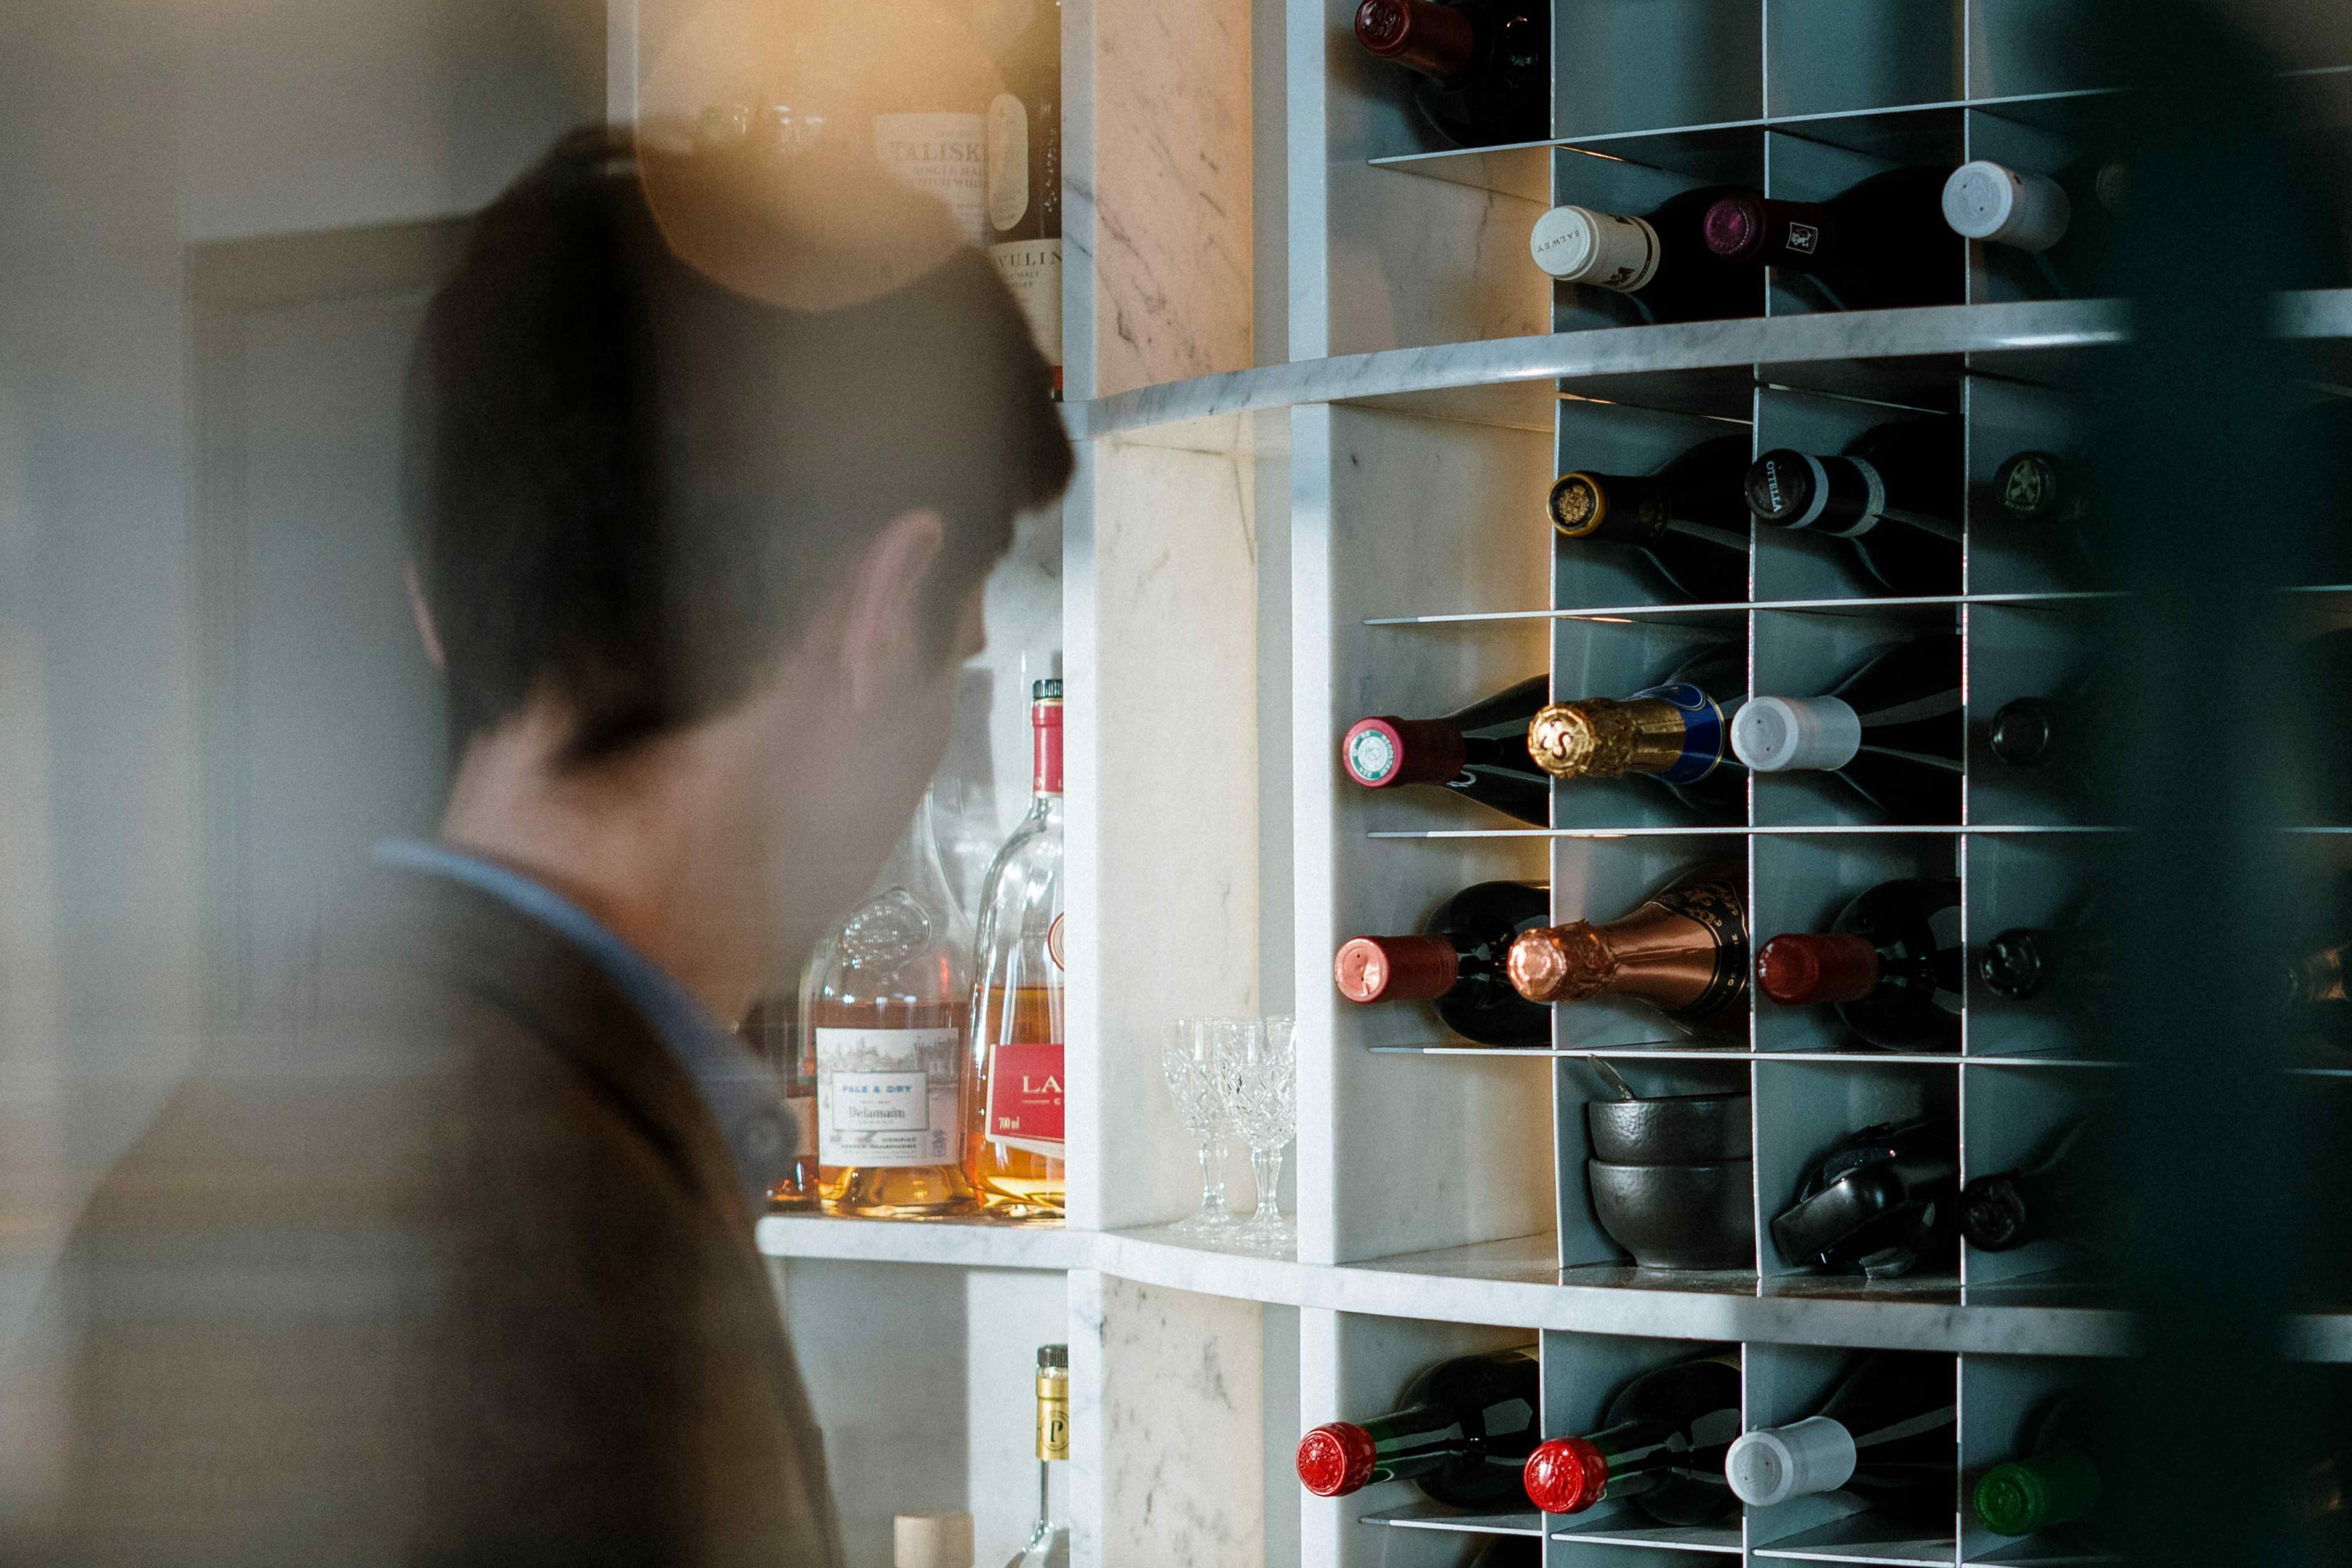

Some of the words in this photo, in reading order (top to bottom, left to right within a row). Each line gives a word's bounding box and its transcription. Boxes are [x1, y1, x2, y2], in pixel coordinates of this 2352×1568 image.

[1538, 229, 1579, 253] SALWEY
[1766, 461, 1782, 512] OTTELLA
[842, 1085, 869, 1093] PALE
[873, 1085, 881, 1094] &
[886, 1085, 912, 1094] DRY
[849, 1106, 905, 1118] Delamain
[999, 1117, 1010, 1129] 700
[1011, 1116, 1020, 1129] ml
[1051, 1420, 1063, 1442] P
